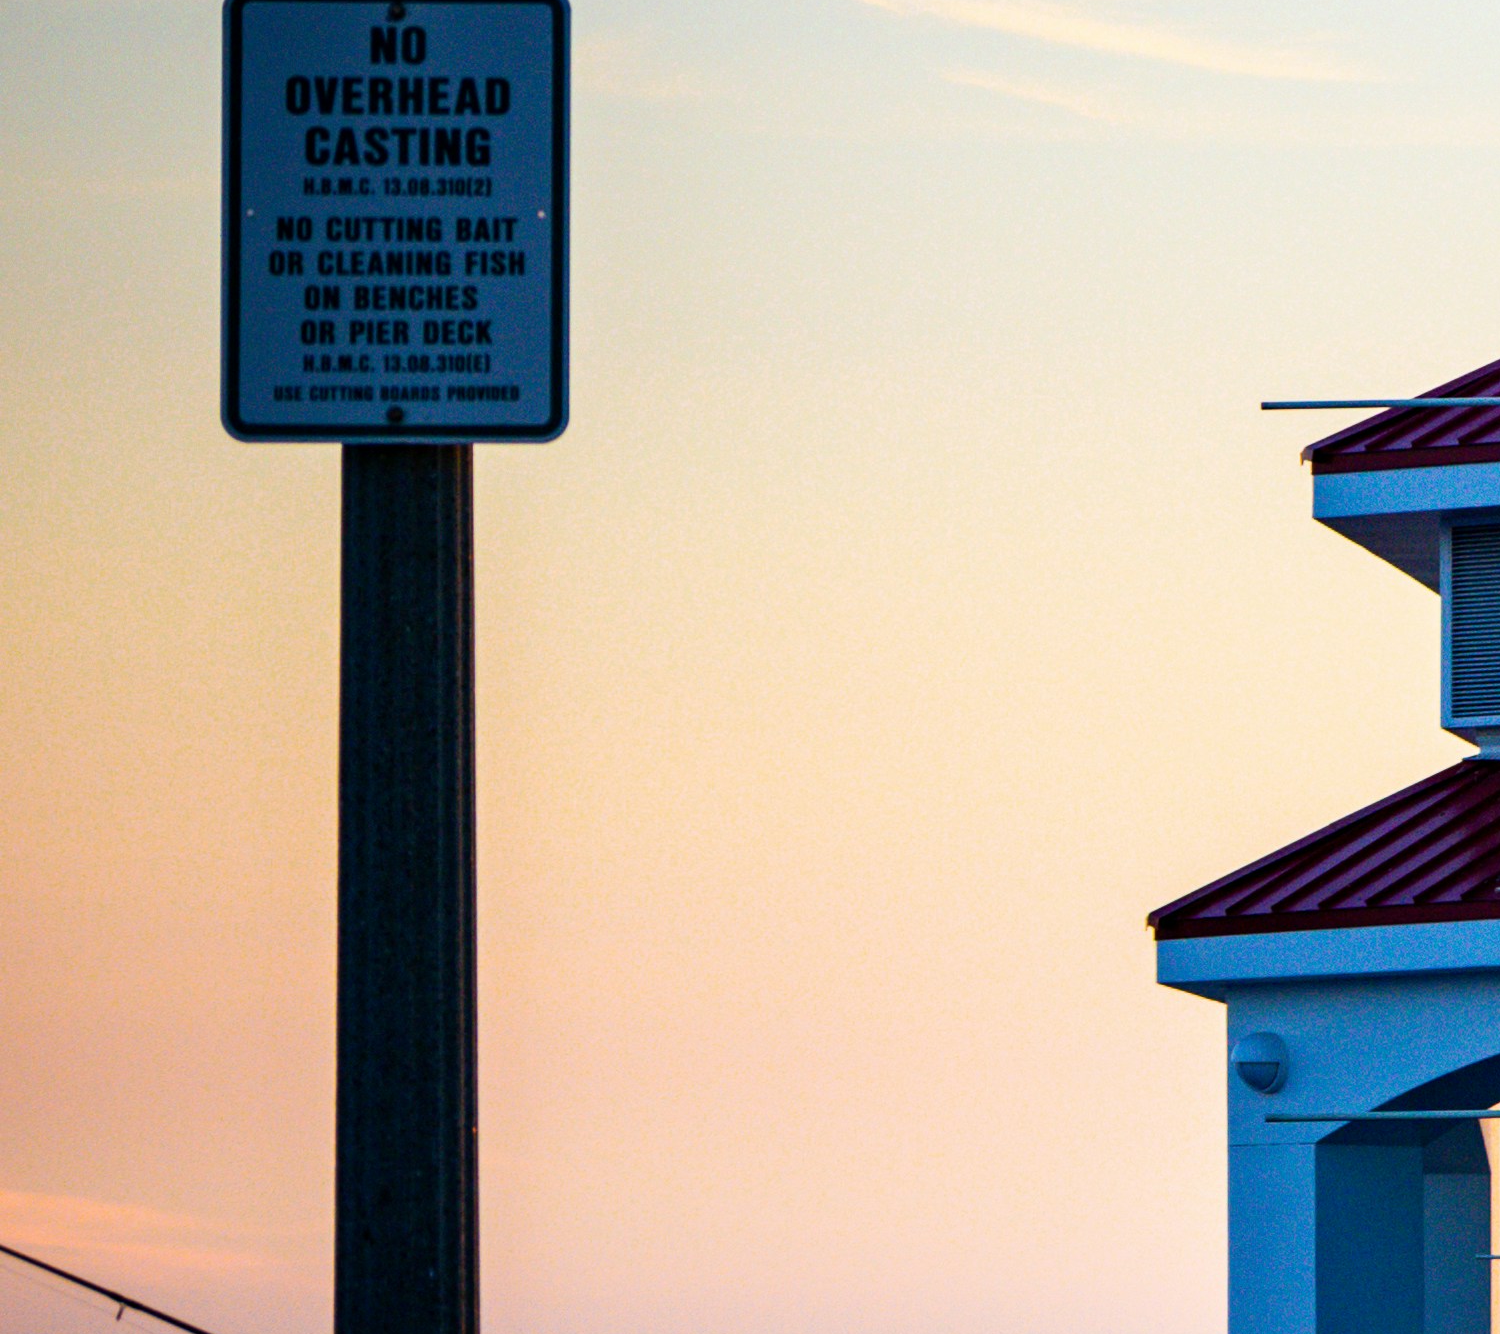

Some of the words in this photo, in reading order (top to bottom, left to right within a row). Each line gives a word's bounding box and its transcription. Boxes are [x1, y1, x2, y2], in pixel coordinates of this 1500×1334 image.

[369, 25, 427, 65] NO
[285, 75, 511, 116] OVERHEAD
[304, 125, 491, 167] CASTING
[276, 216, 312, 242] NO
[325, 215, 442, 242] CUTTING
[456, 216, 517, 243] BAIT
[268, 250, 303, 276] OR
[317, 250, 451, 277] CLEANING
[465, 250, 525, 276] FISH
[303, 285, 340, 311] ON
[353, 285, 478, 312] BENCHES
[300, 319, 335, 346] OR
[349, 319, 410, 346] PIER
[423, 320, 492, 346] DECK
[273, 384, 301, 402] USE
[308, 384, 374, 402] CUTTING
[379, 384, 440, 402] BOARDS
[447, 384, 520, 402] PROVIDED
